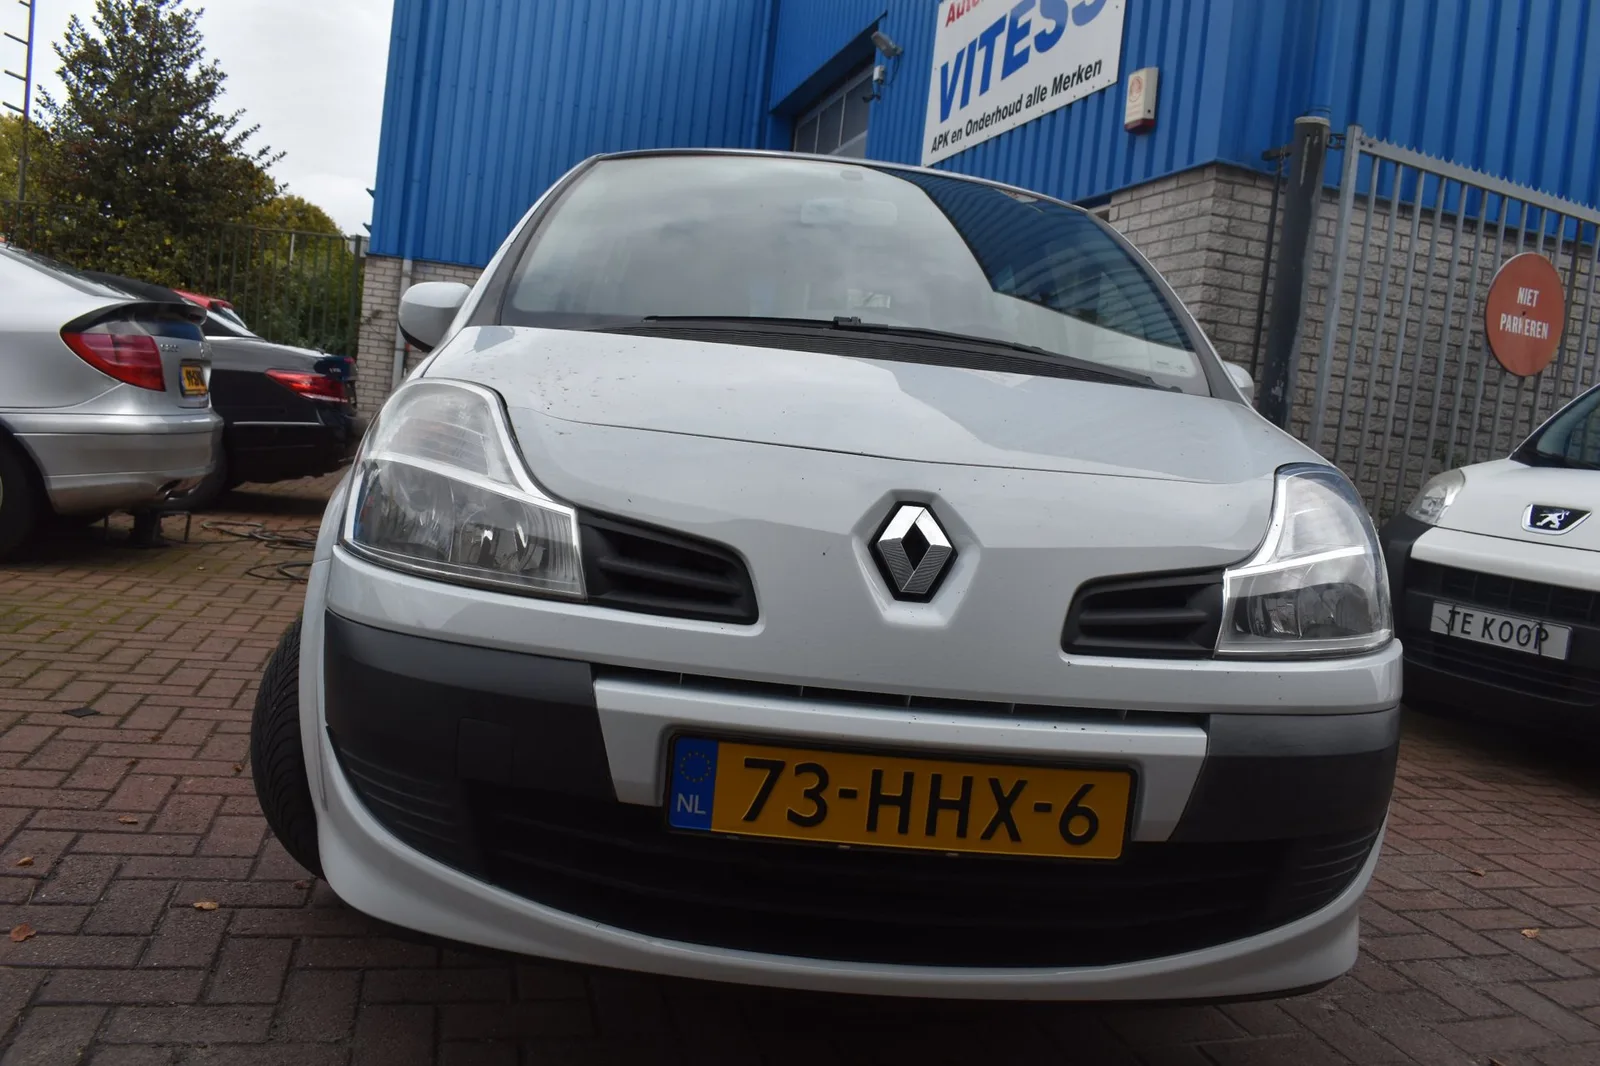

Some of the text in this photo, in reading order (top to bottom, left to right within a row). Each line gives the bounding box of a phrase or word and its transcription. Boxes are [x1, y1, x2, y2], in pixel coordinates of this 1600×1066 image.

[931, 59, 1102, 153] APK en Onderhoud alle Merken
[1517, 287, 1539, 307] NIET
[1449, 609, 1549, 650] TE KOOP
[677, 793, 706, 815] NL
[741, 756, 1100, 846] 73-HHX-6
